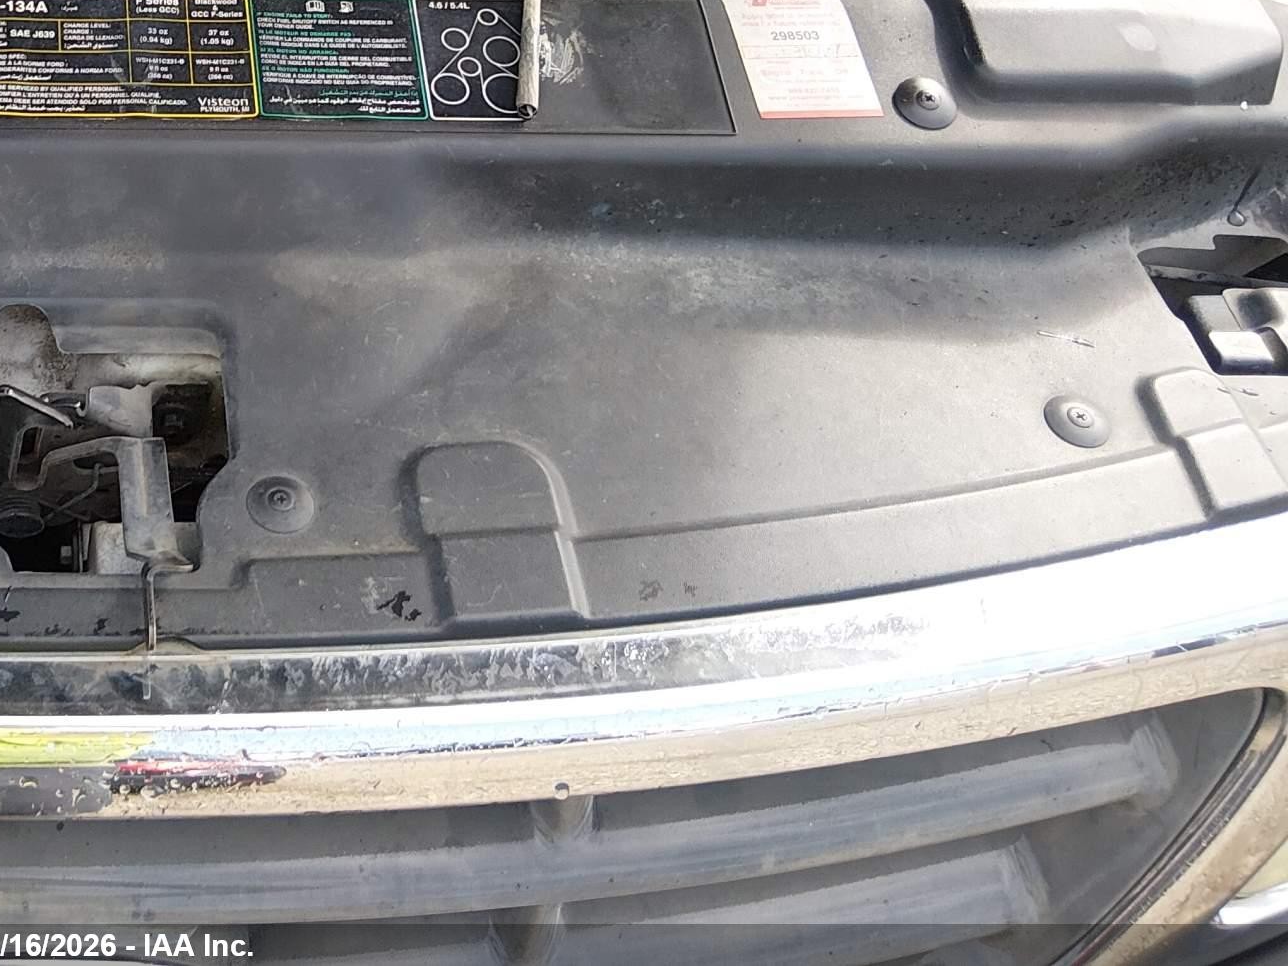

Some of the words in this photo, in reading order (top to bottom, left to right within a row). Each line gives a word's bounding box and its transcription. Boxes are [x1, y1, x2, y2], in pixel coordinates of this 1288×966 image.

[428, 2, 443, 10] 4.6
[159, 7, 179, 15] GCC)
[10, 29, 31, 37] SAE
[32, 30, 56, 39] J639
[771, 31, 819, 40] 298503
[198, 97, 248, 106] Visteon
